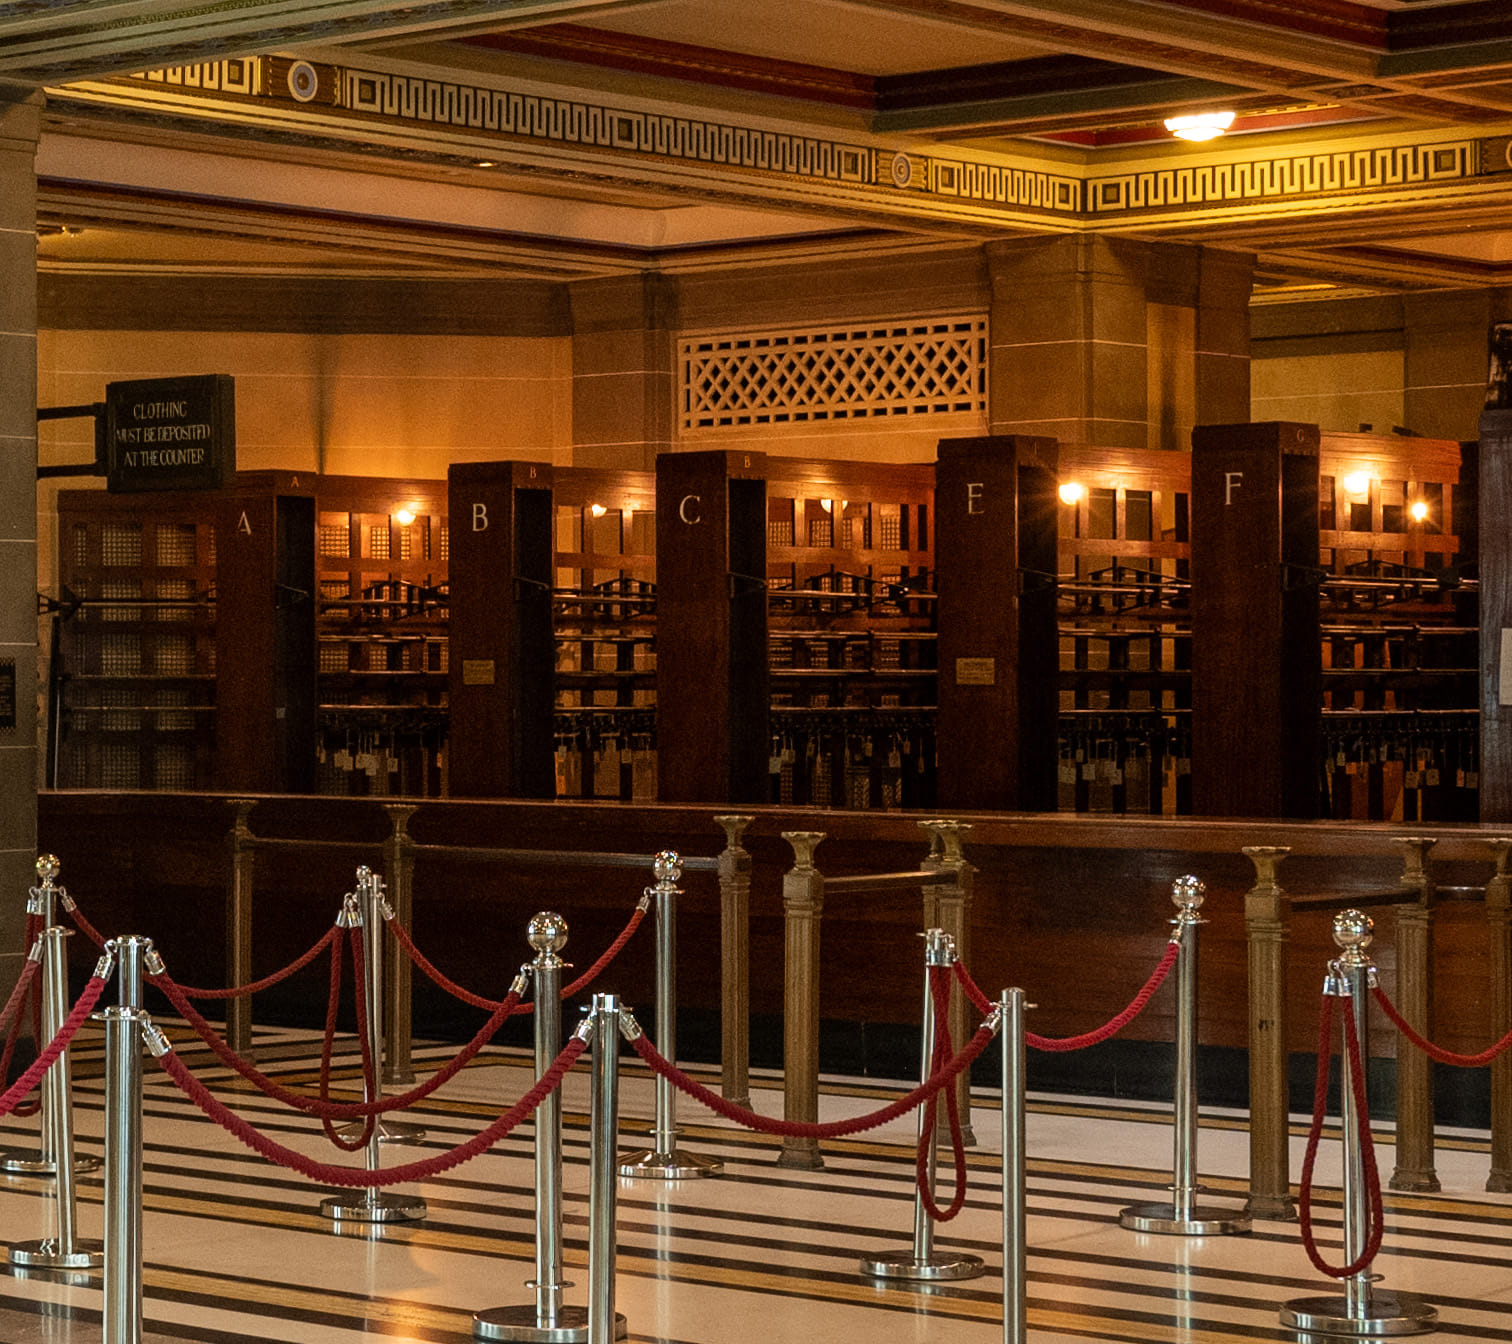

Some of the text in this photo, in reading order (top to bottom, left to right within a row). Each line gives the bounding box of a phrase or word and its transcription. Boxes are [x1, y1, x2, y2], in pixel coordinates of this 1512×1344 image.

[133, 401, 187, 420] CLOTHING
[116, 424, 211, 443] MUST BE DEPOSITED
[124, 447, 205, 467] AT THE COUNTER
[967, 483, 985, 514] E
[1224, 472, 1244, 505] F
[237, 510, 252, 536] A
[472, 503, 489, 532] B
[679, 495, 701, 525] C
